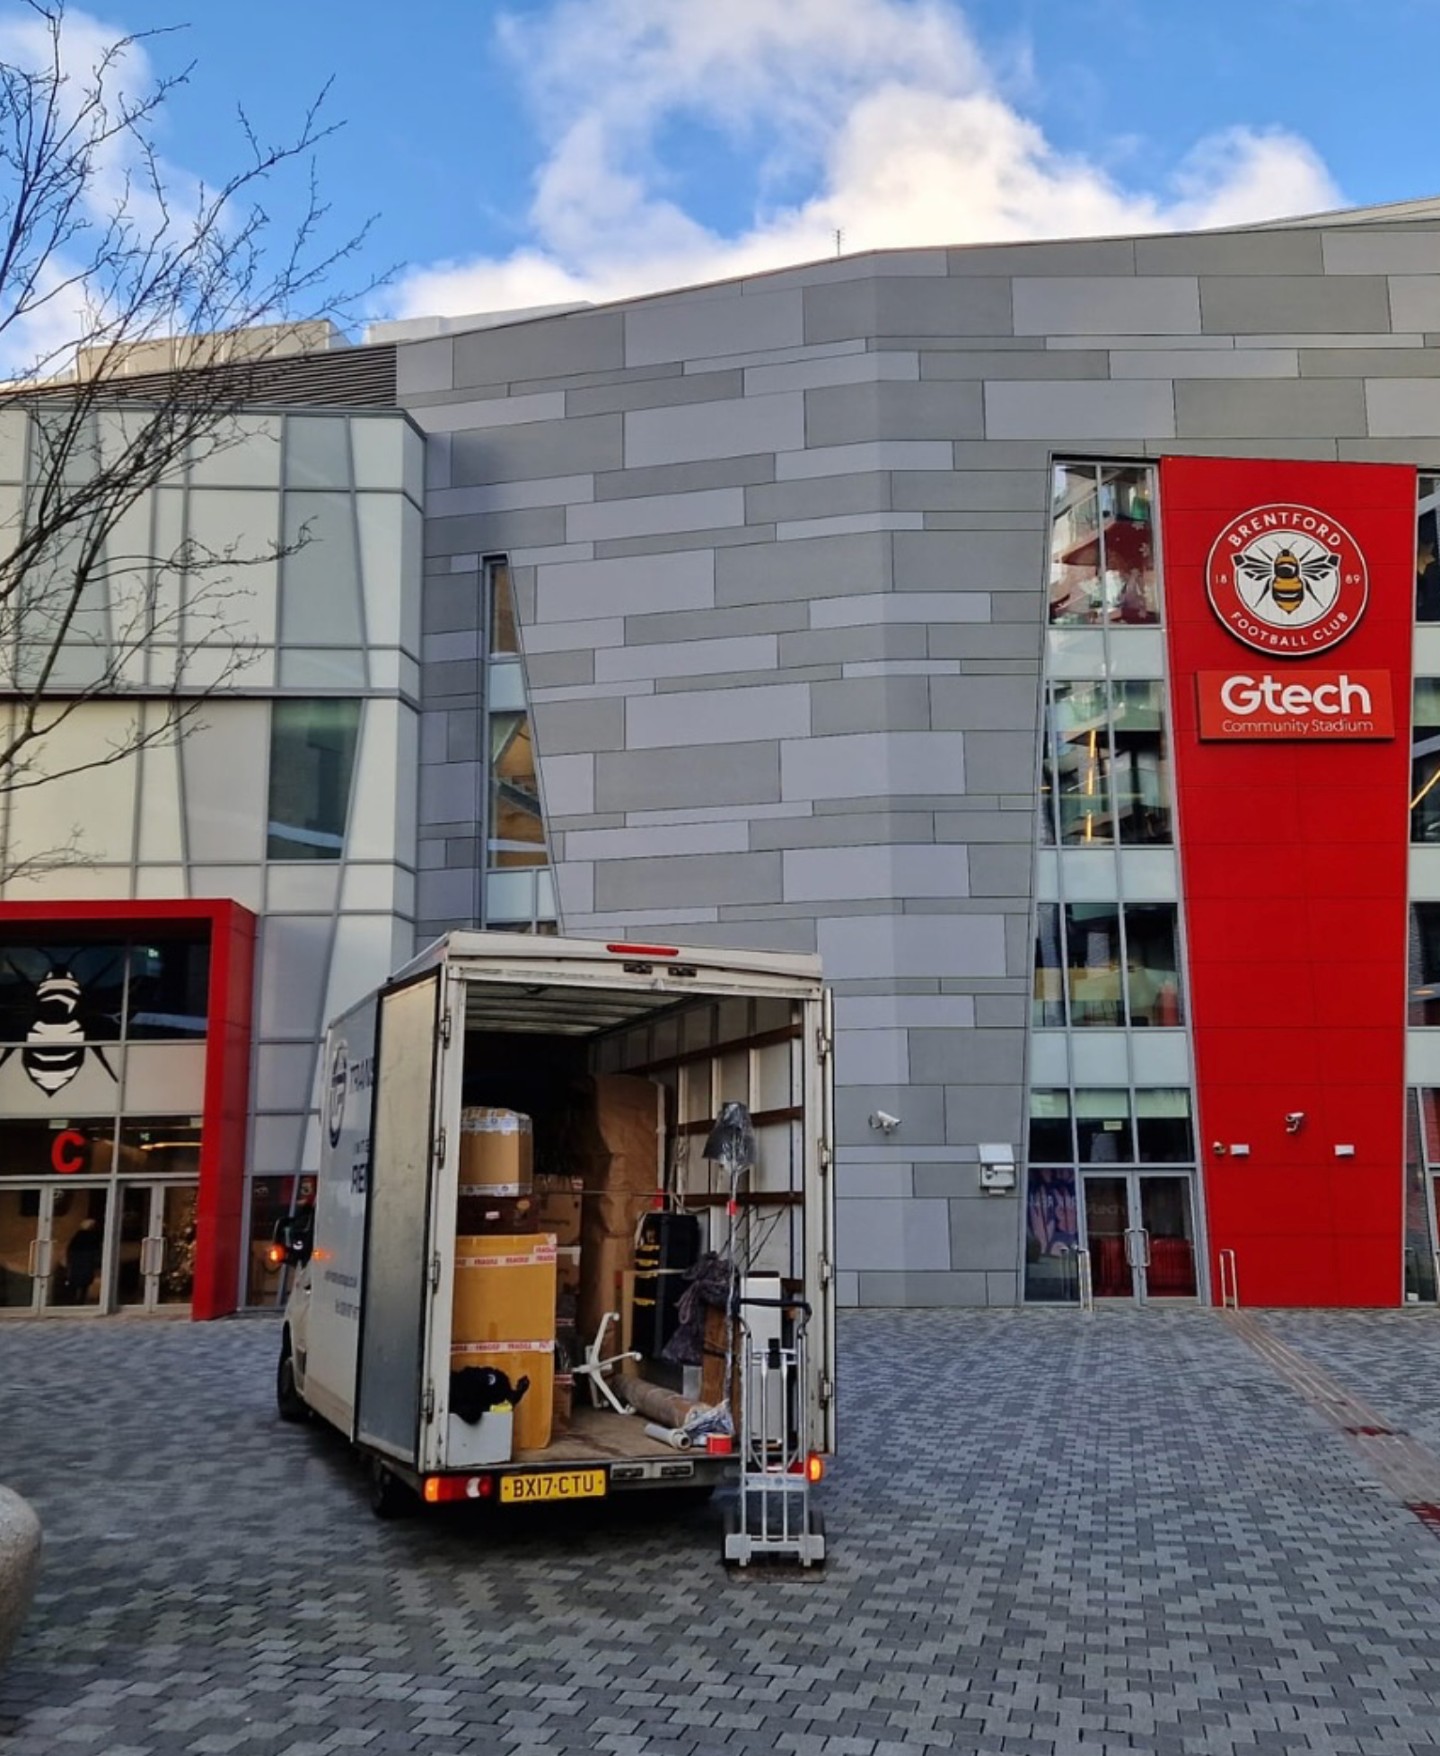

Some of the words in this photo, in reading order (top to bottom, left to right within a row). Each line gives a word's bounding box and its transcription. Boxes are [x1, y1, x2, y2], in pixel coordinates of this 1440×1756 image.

[1228, 512, 1341, 547] BRENTFORD
[1215, 574, 1228, 584] 18
[1345, 574, 1361, 584] 89
[1231, 611, 1308, 647] FOOTBALL
[1313, 611, 1349, 642] CLUB
[1221, 674, 1372, 715] Gtech
[1222, 718, 1309, 735] Community
[1312, 719, 1374, 733] Stadium
[51, 1131, 86, 1174] C
[513, 1477, 553, 1498] BX17
[558, 1474, 594, 1494] CTU
